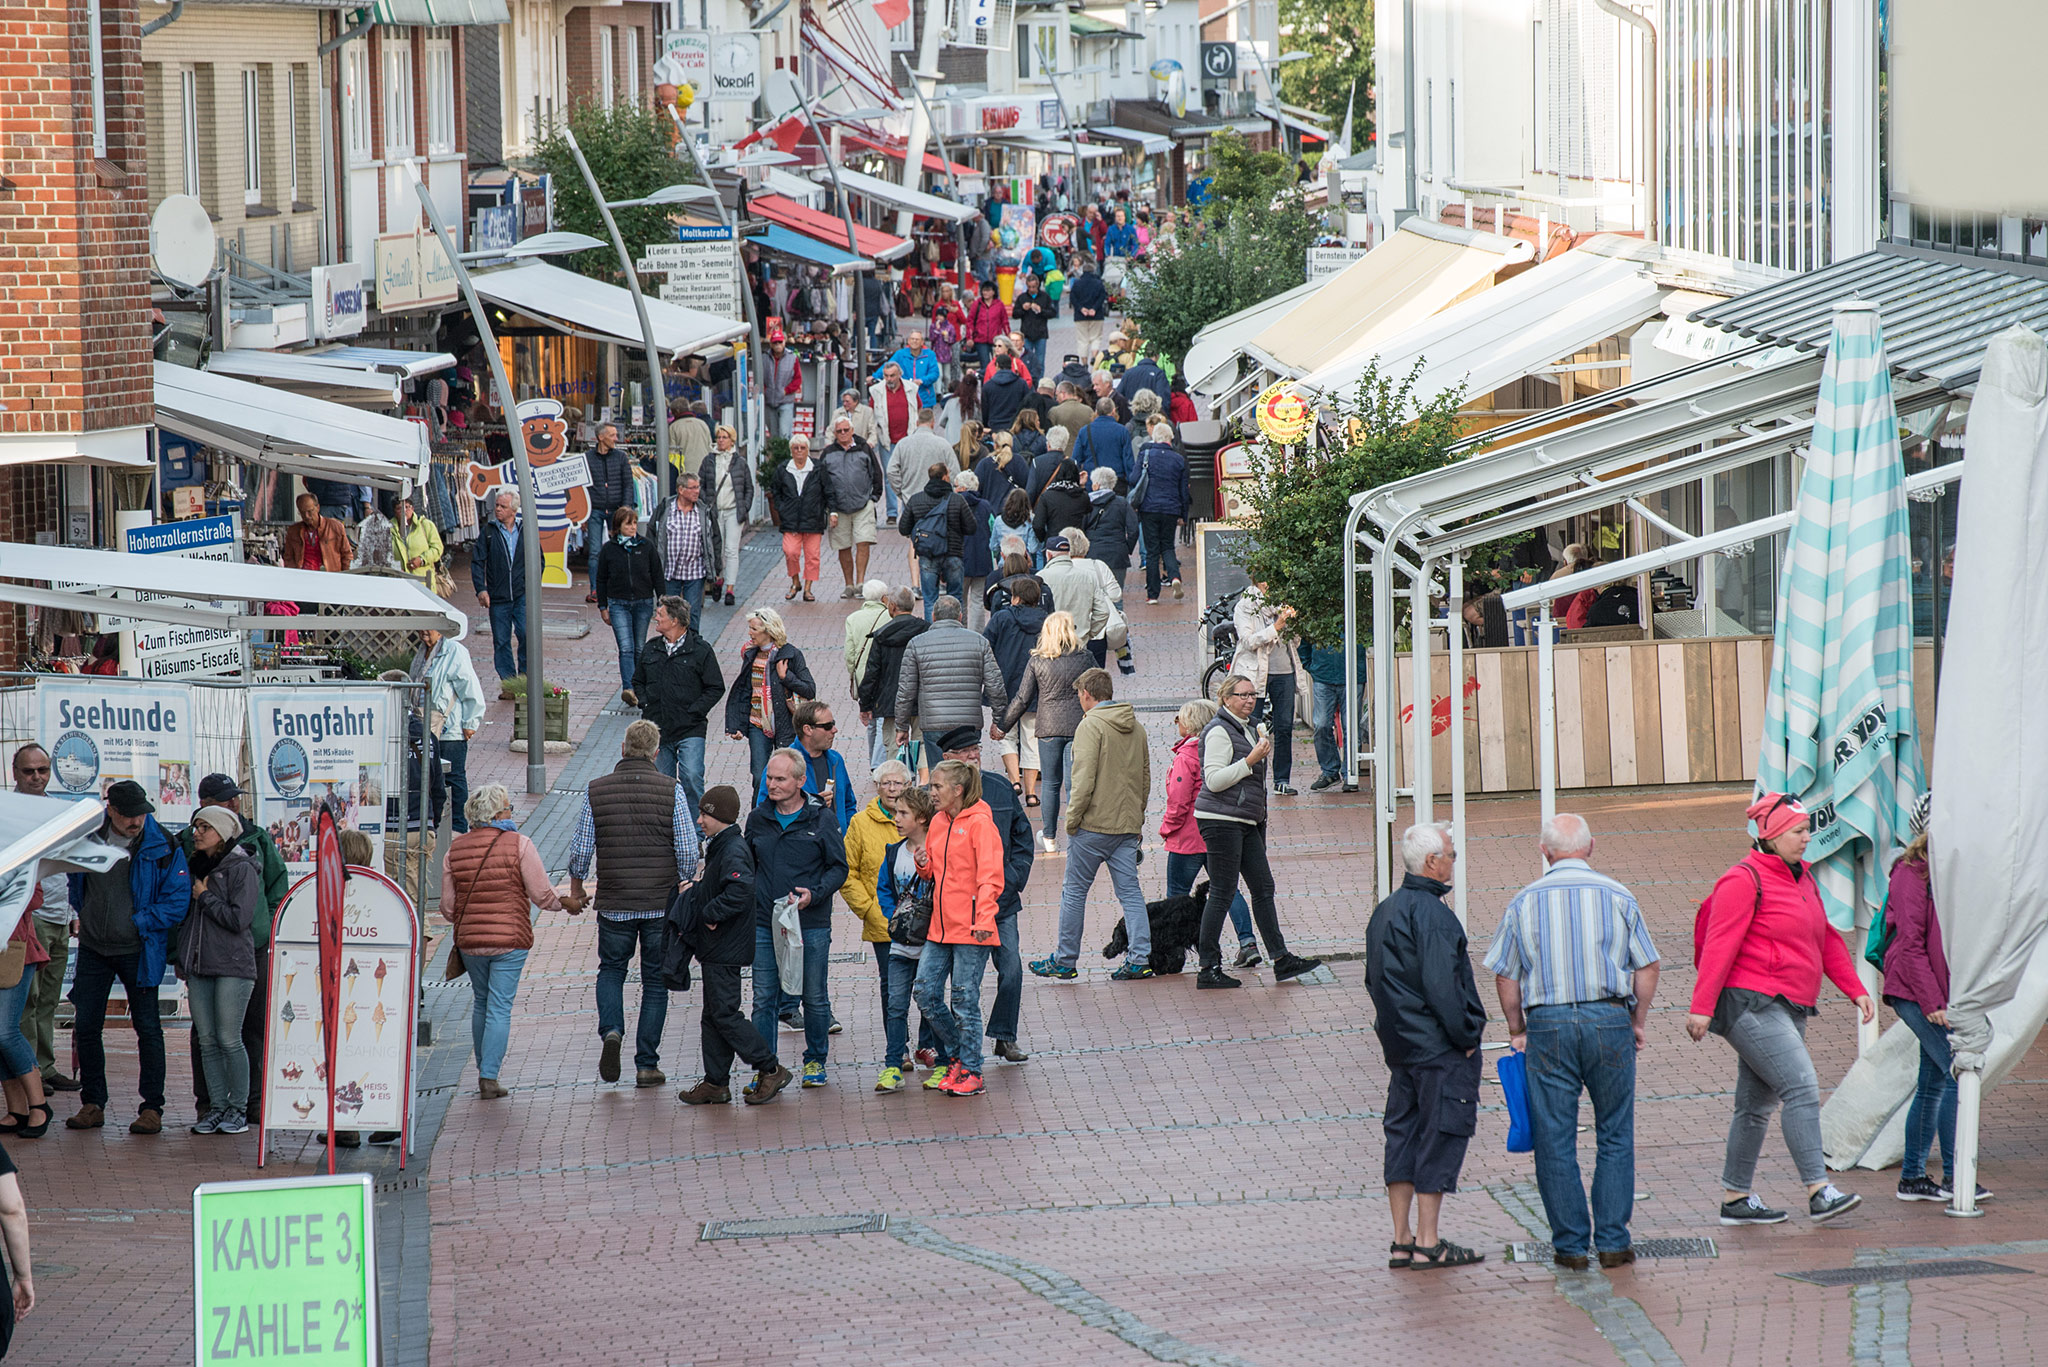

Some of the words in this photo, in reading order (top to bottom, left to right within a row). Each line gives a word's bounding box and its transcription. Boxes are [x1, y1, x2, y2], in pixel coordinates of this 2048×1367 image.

[671, 51, 705, 60] Pizzeria
[714, 71, 754, 88] NORDIA
[682, 228, 729, 238] Moltkestraße
[652, 246, 671, 256] Leder
[1315, 250, 1347, 260] Bernstein
[638, 261, 653, 270] Café
[656, 261, 677, 269] Bohne
[701, 258, 732, 268] Seemeile
[673, 272, 702, 281] Juwelier
[705, 271, 729, 280] Kremin
[690, 284, 722, 292] Restaurant
[714, 302, 731, 311] 2000
[129, 522, 233, 552] Hohenzollernstraße
[144, 634, 166, 651] Zum
[168, 628, 233, 649] Fischmeister
[154, 648, 239, 677] Büsums-Eiscafé
[59, 699, 177, 733] Seehunde
[273, 705, 374, 743] Fangfahrt
[104, 738, 114, 746] mit
[115, 739, 123, 747] MS
[313, 748, 322, 757] mit
[323, 748, 331, 756] MS
[364, 1083, 388, 1091] HEISS
[212, 1213, 325, 1272] KAUFE
[335, 1211, 361, 1274] 3,
[211, 1300, 323, 1360] ZAHLE
